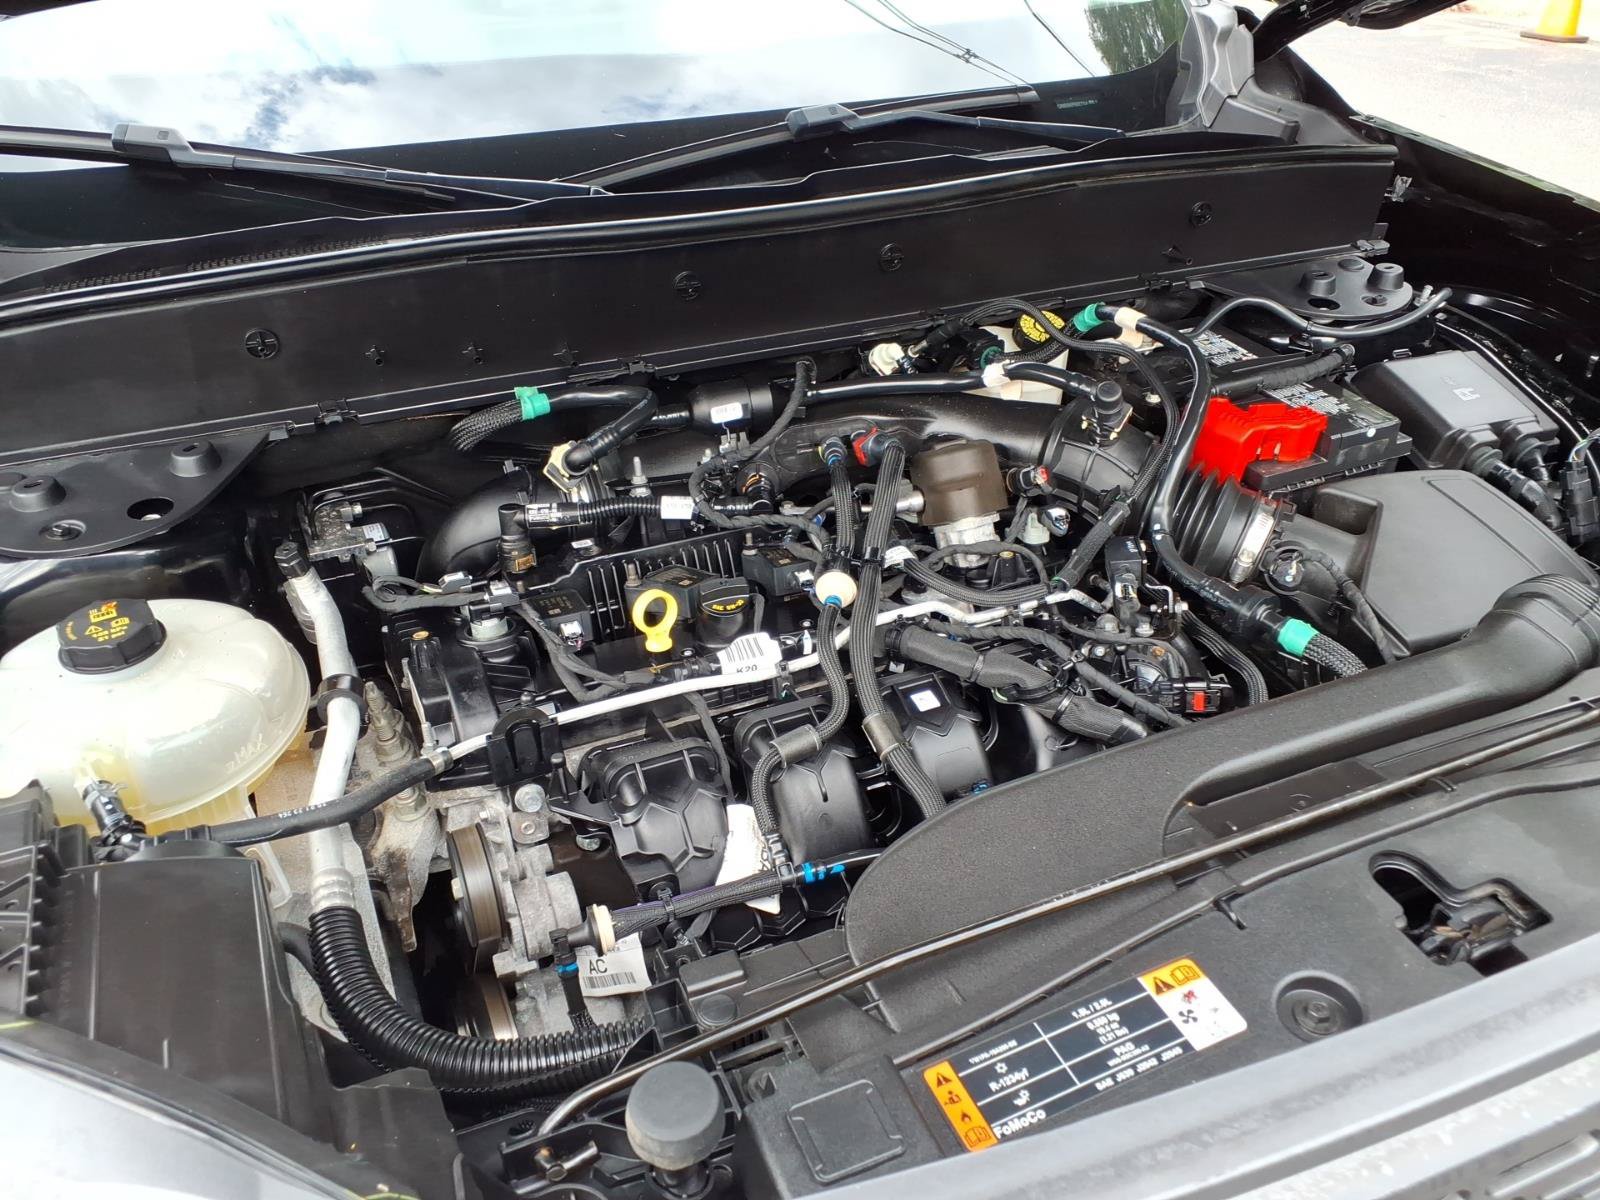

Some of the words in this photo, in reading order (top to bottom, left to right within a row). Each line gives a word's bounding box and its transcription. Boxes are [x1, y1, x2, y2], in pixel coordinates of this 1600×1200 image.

[588, 958, 608, 976] AC
[988, 1067, 1029, 1092] R-1234yf
[992, 1109, 1046, 1139] FoMoCo
